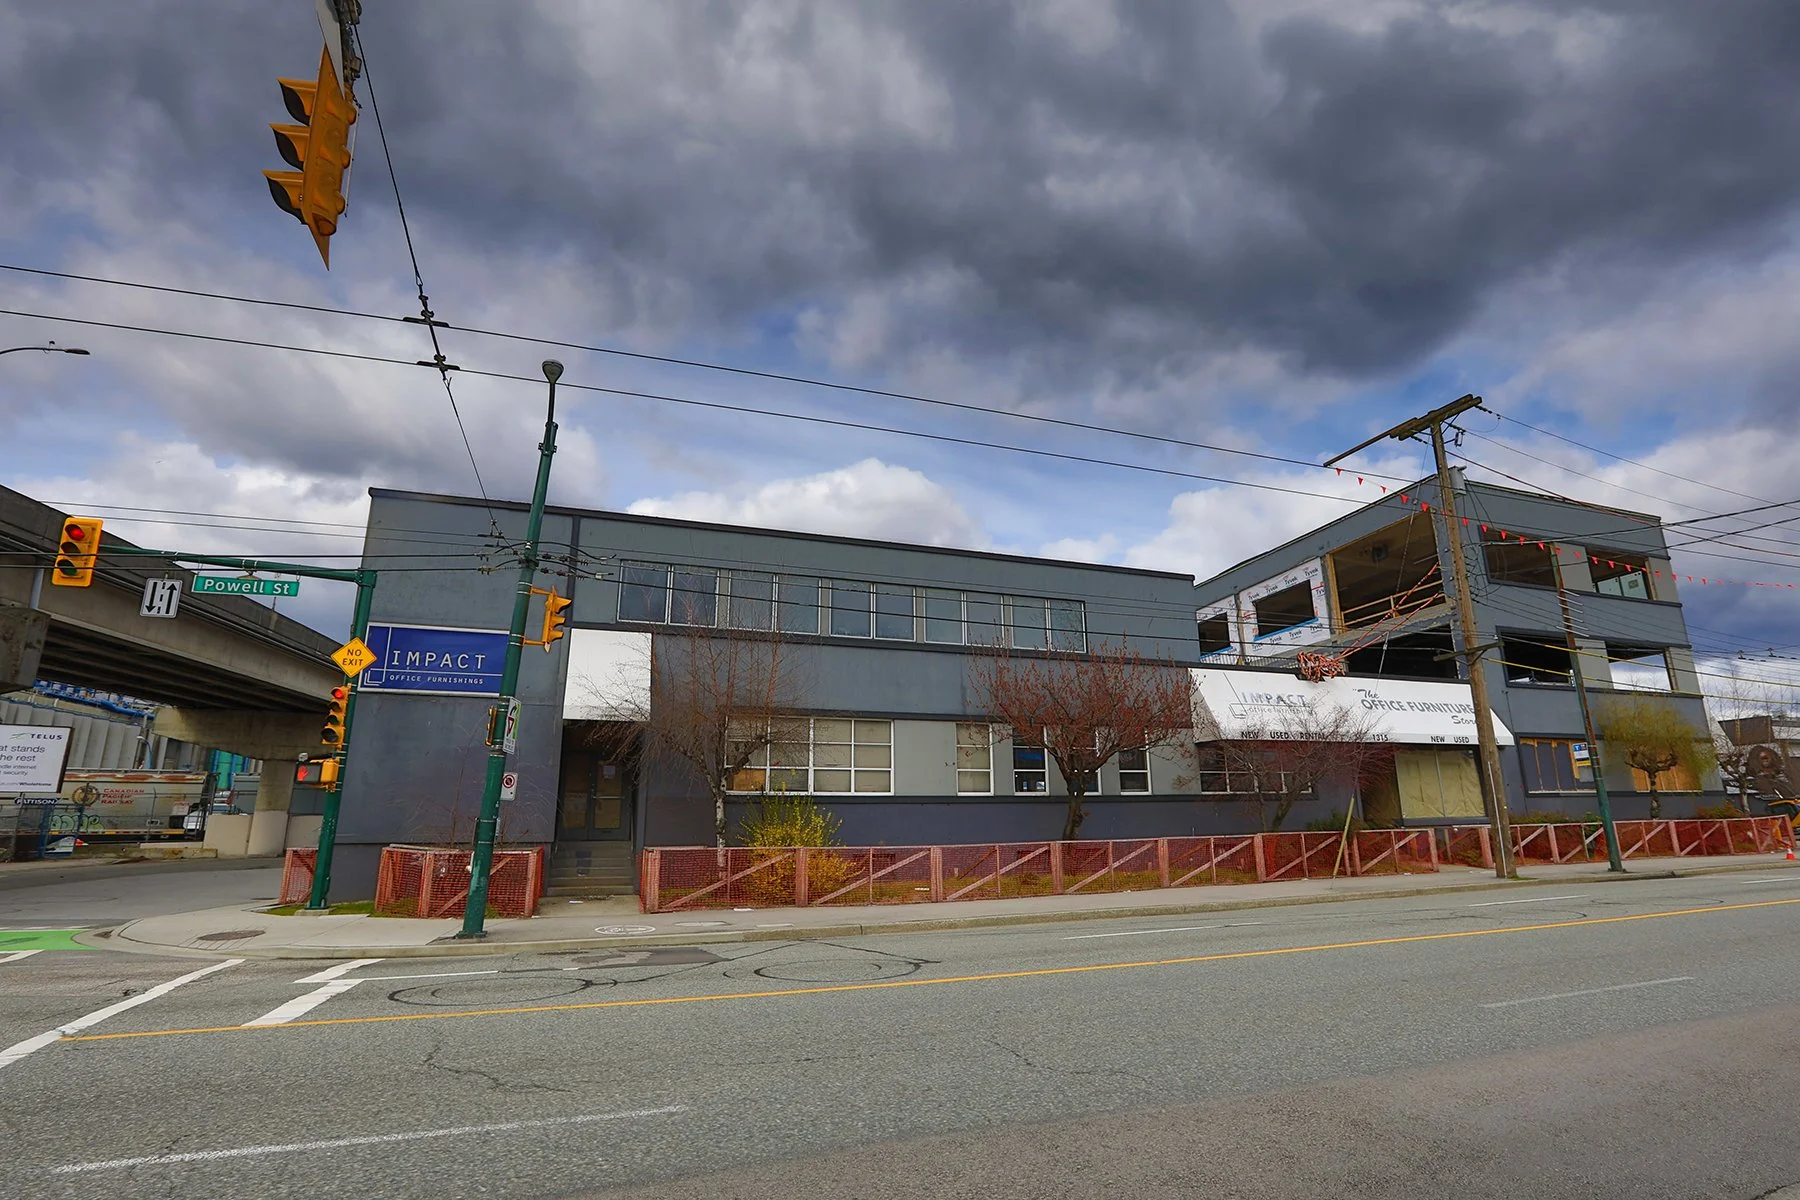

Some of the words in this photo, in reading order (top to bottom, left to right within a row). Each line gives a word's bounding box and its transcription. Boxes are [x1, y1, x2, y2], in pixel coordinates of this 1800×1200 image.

[203, 579, 265, 593] Powell
[273, 583, 290, 594] St
[346, 649, 362, 657] NO
[342, 658, 364, 666] EXIT
[391, 650, 486, 669] IMPACT
[389, 674, 421, 682] OFFICE
[427, 676, 484, 685] FURNISHINGS
[1241, 691, 1306, 707] IMPACT
[1361, 699, 1407, 712] OFFICE
[1408, 701, 1475, 714] FURNITURE
[1451, 715, 1478, 725] Stor
[1241, 731, 1259, 739] NEW
[1269, 731, 1290, 740] USED
[1300, 732, 1326, 740] RENTAL
[1372, 733, 1389, 742] 1315
[1430, 735, 1446, 743] NEW
[11, 745, 46, 753] stands
